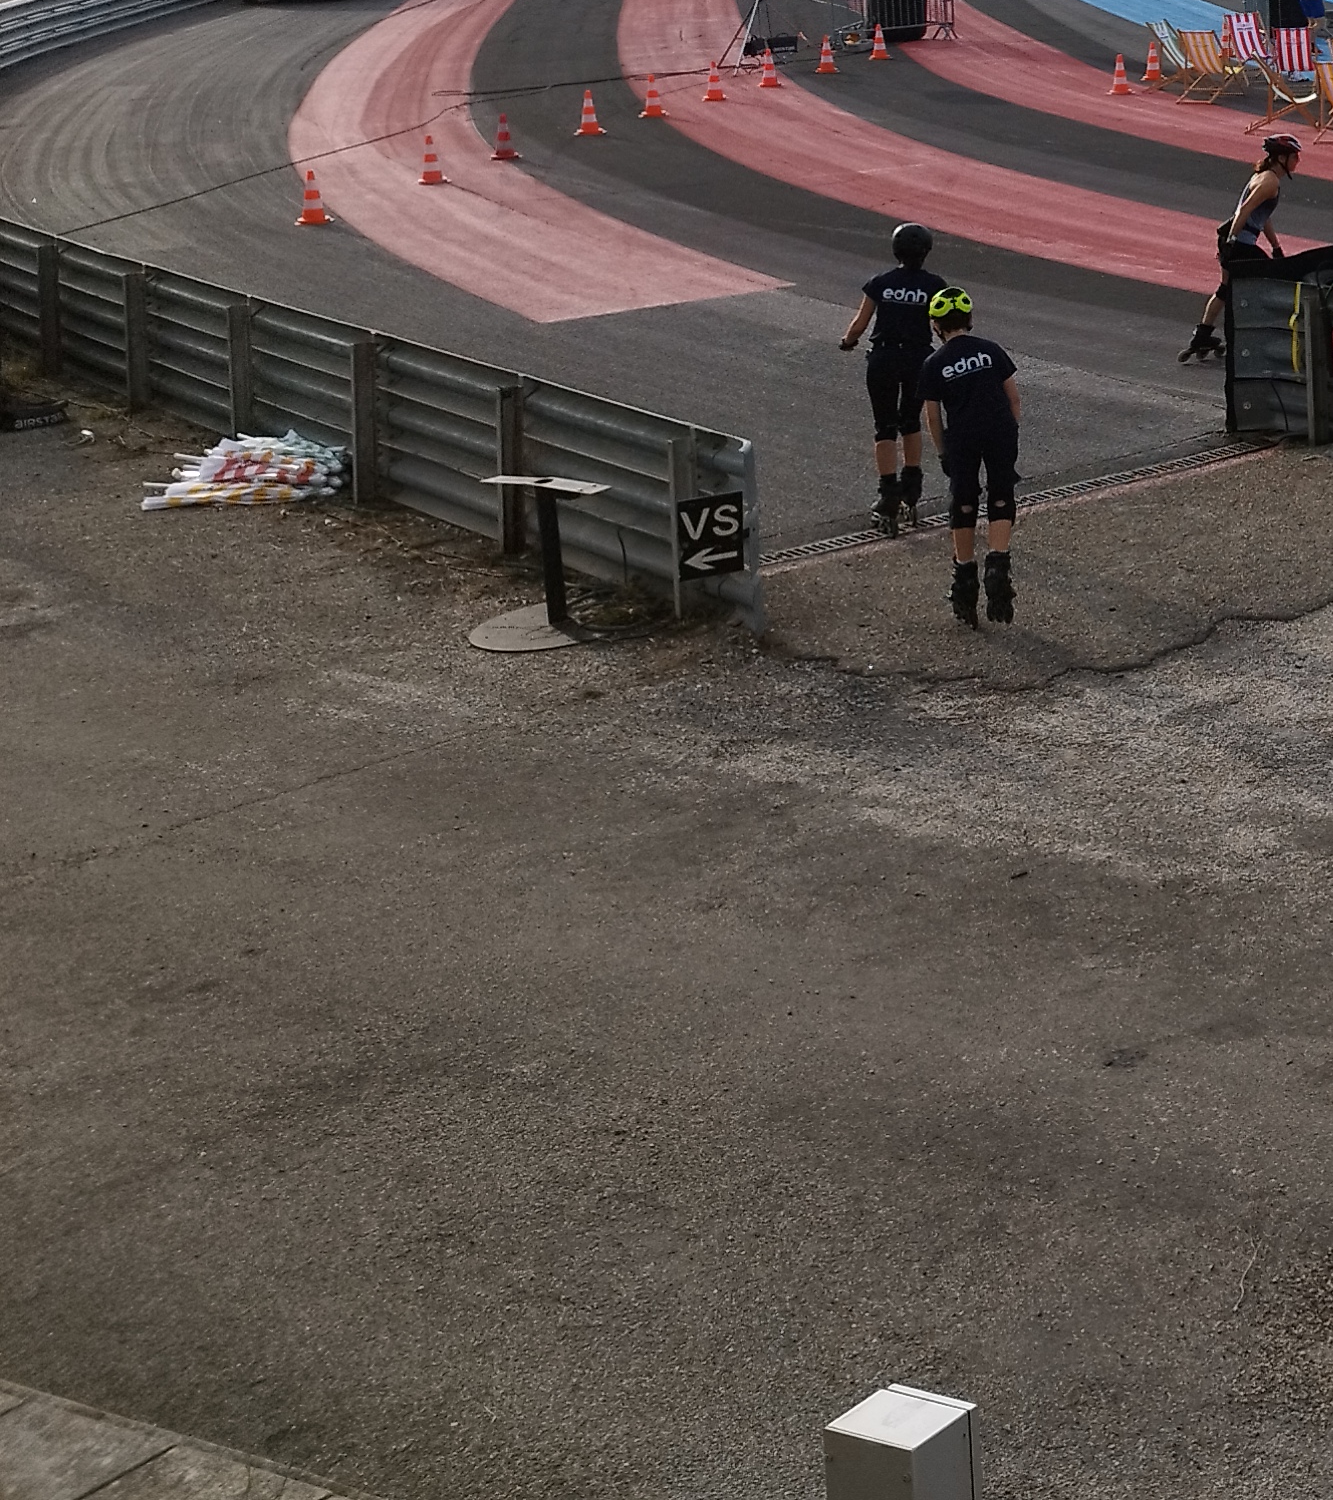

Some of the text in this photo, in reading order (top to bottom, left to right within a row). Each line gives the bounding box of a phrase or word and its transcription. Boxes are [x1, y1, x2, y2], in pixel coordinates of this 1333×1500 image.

[882, 287, 928, 303] ednh
[942, 352, 993, 378] ednh
[680, 504, 739, 540] VS
